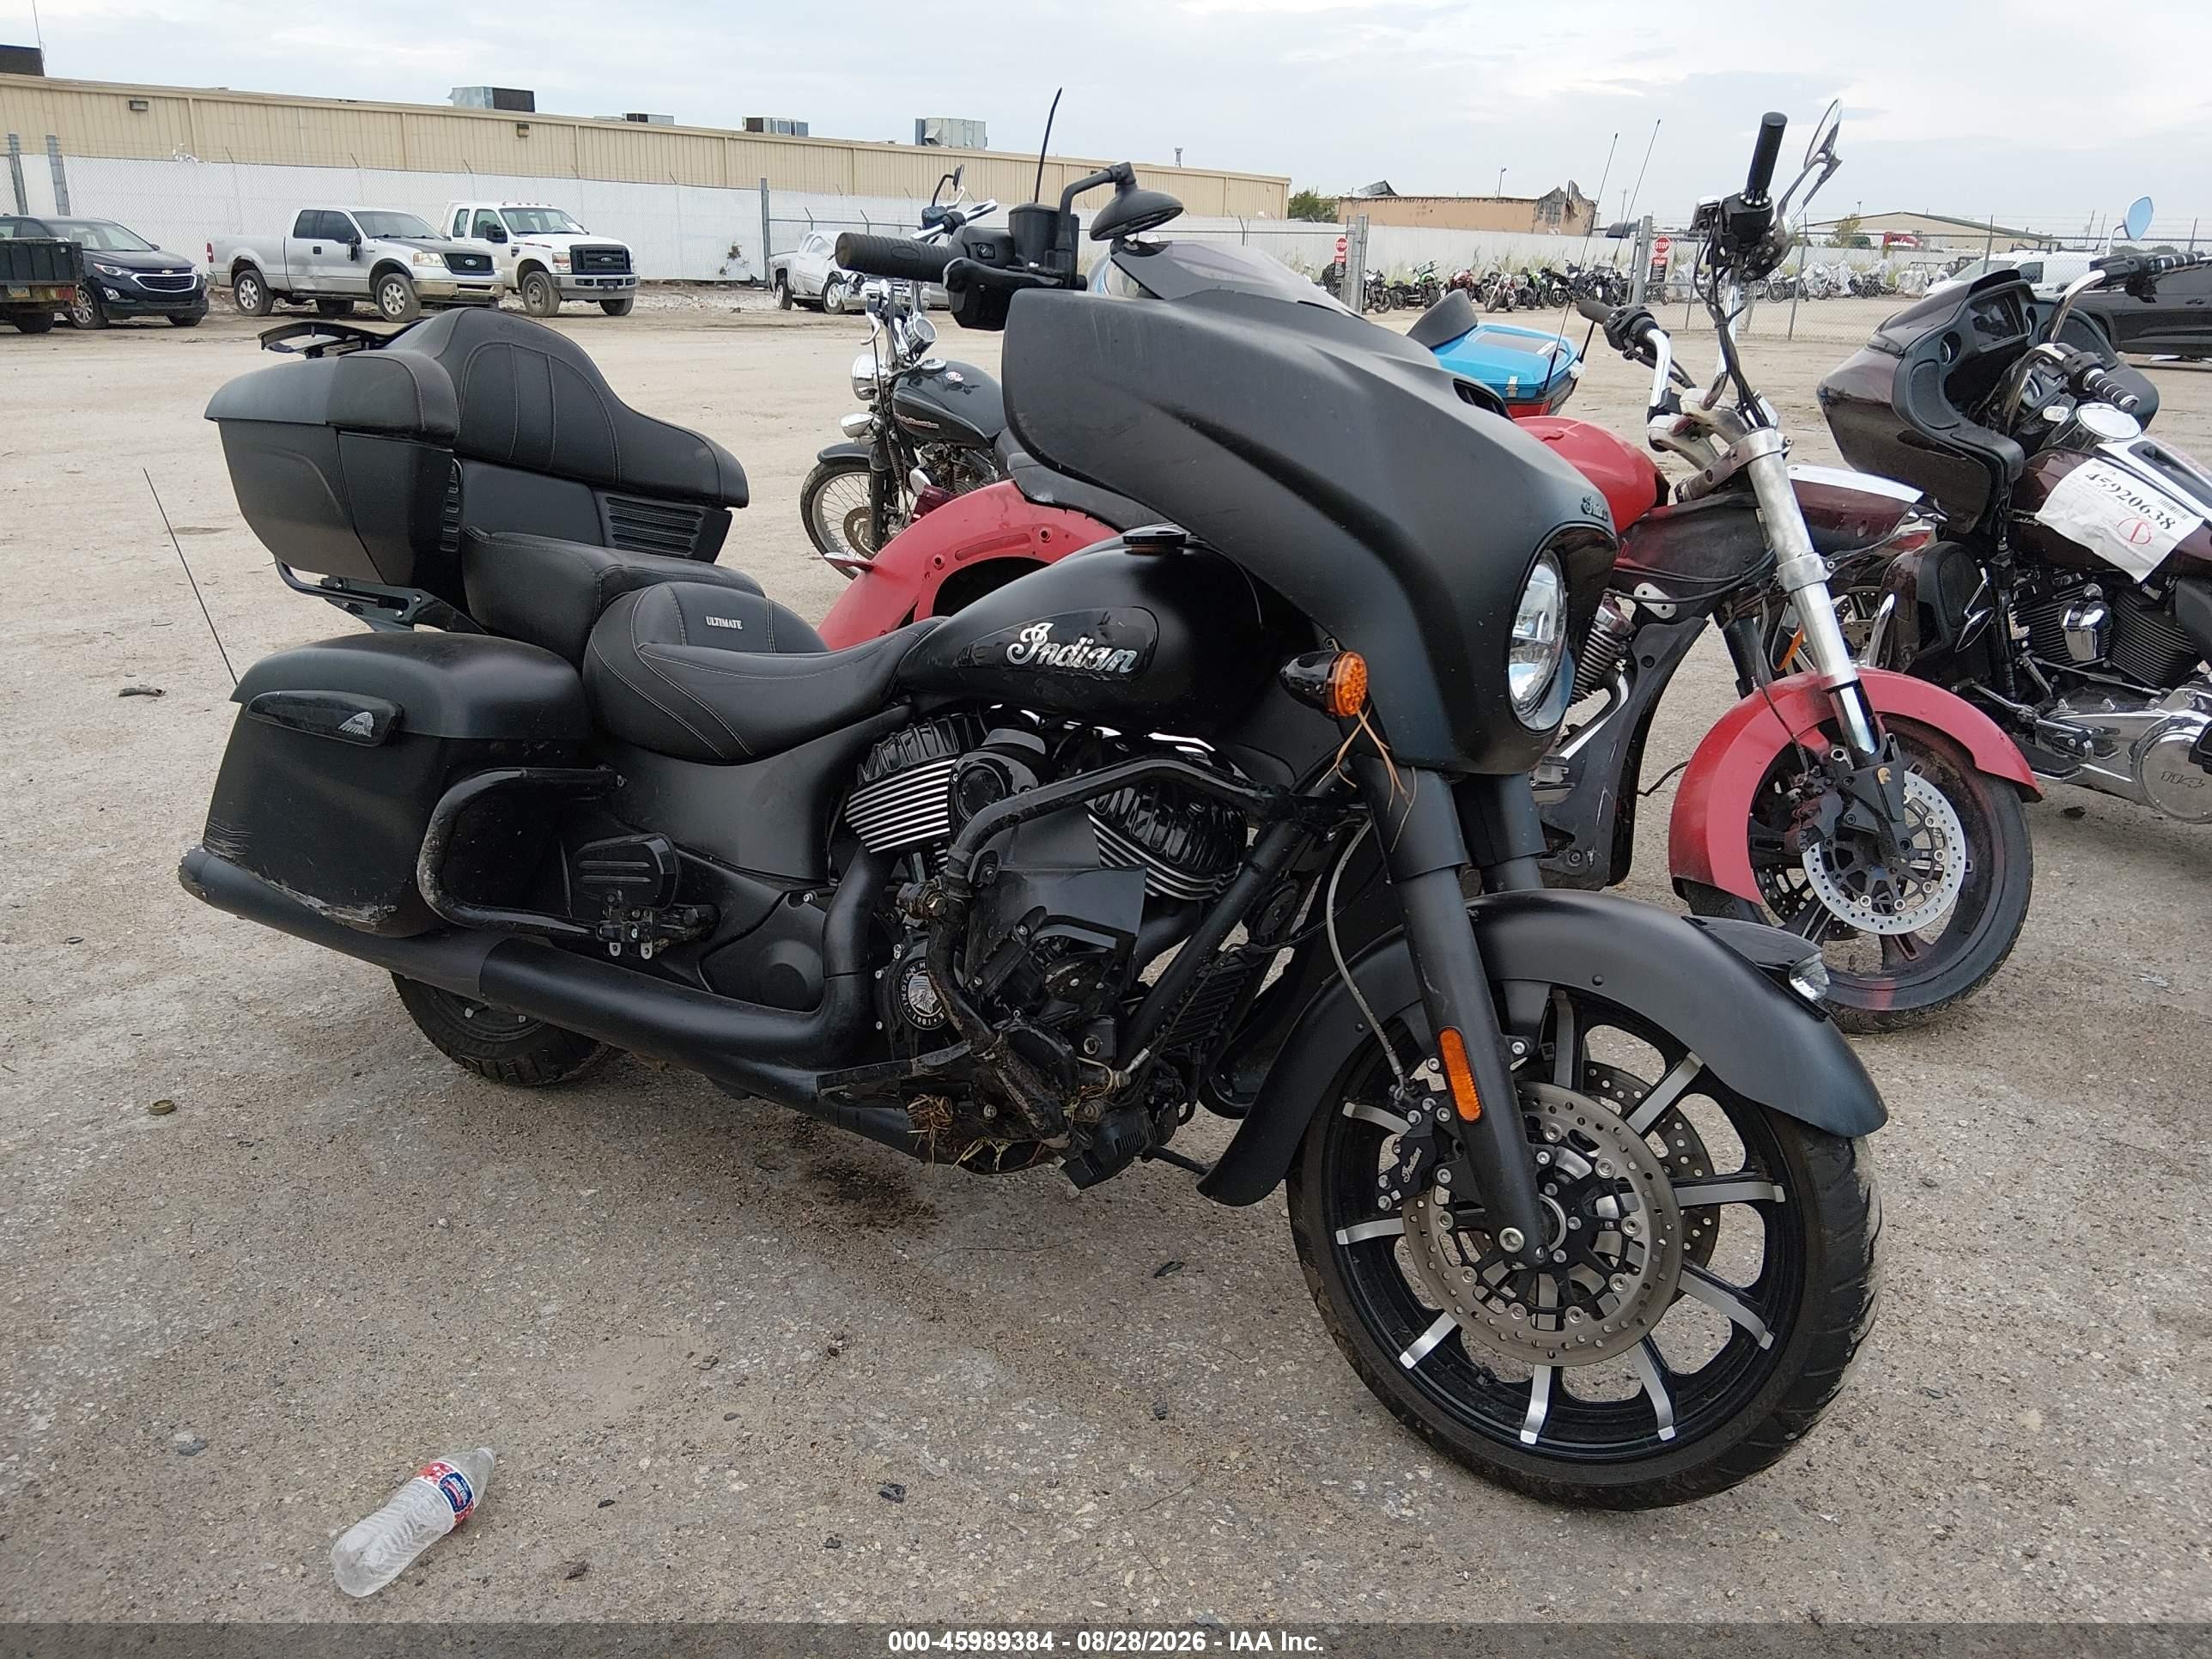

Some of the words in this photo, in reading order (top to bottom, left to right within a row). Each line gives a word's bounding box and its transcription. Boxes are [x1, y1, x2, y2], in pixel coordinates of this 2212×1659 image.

[2085, 473, 2176, 530] 45920638
[705, 615, 743, 630] ULTIMATE
[1006, 622, 1139, 674] Indian
[1401, 1146, 1423, 1183] Indian
